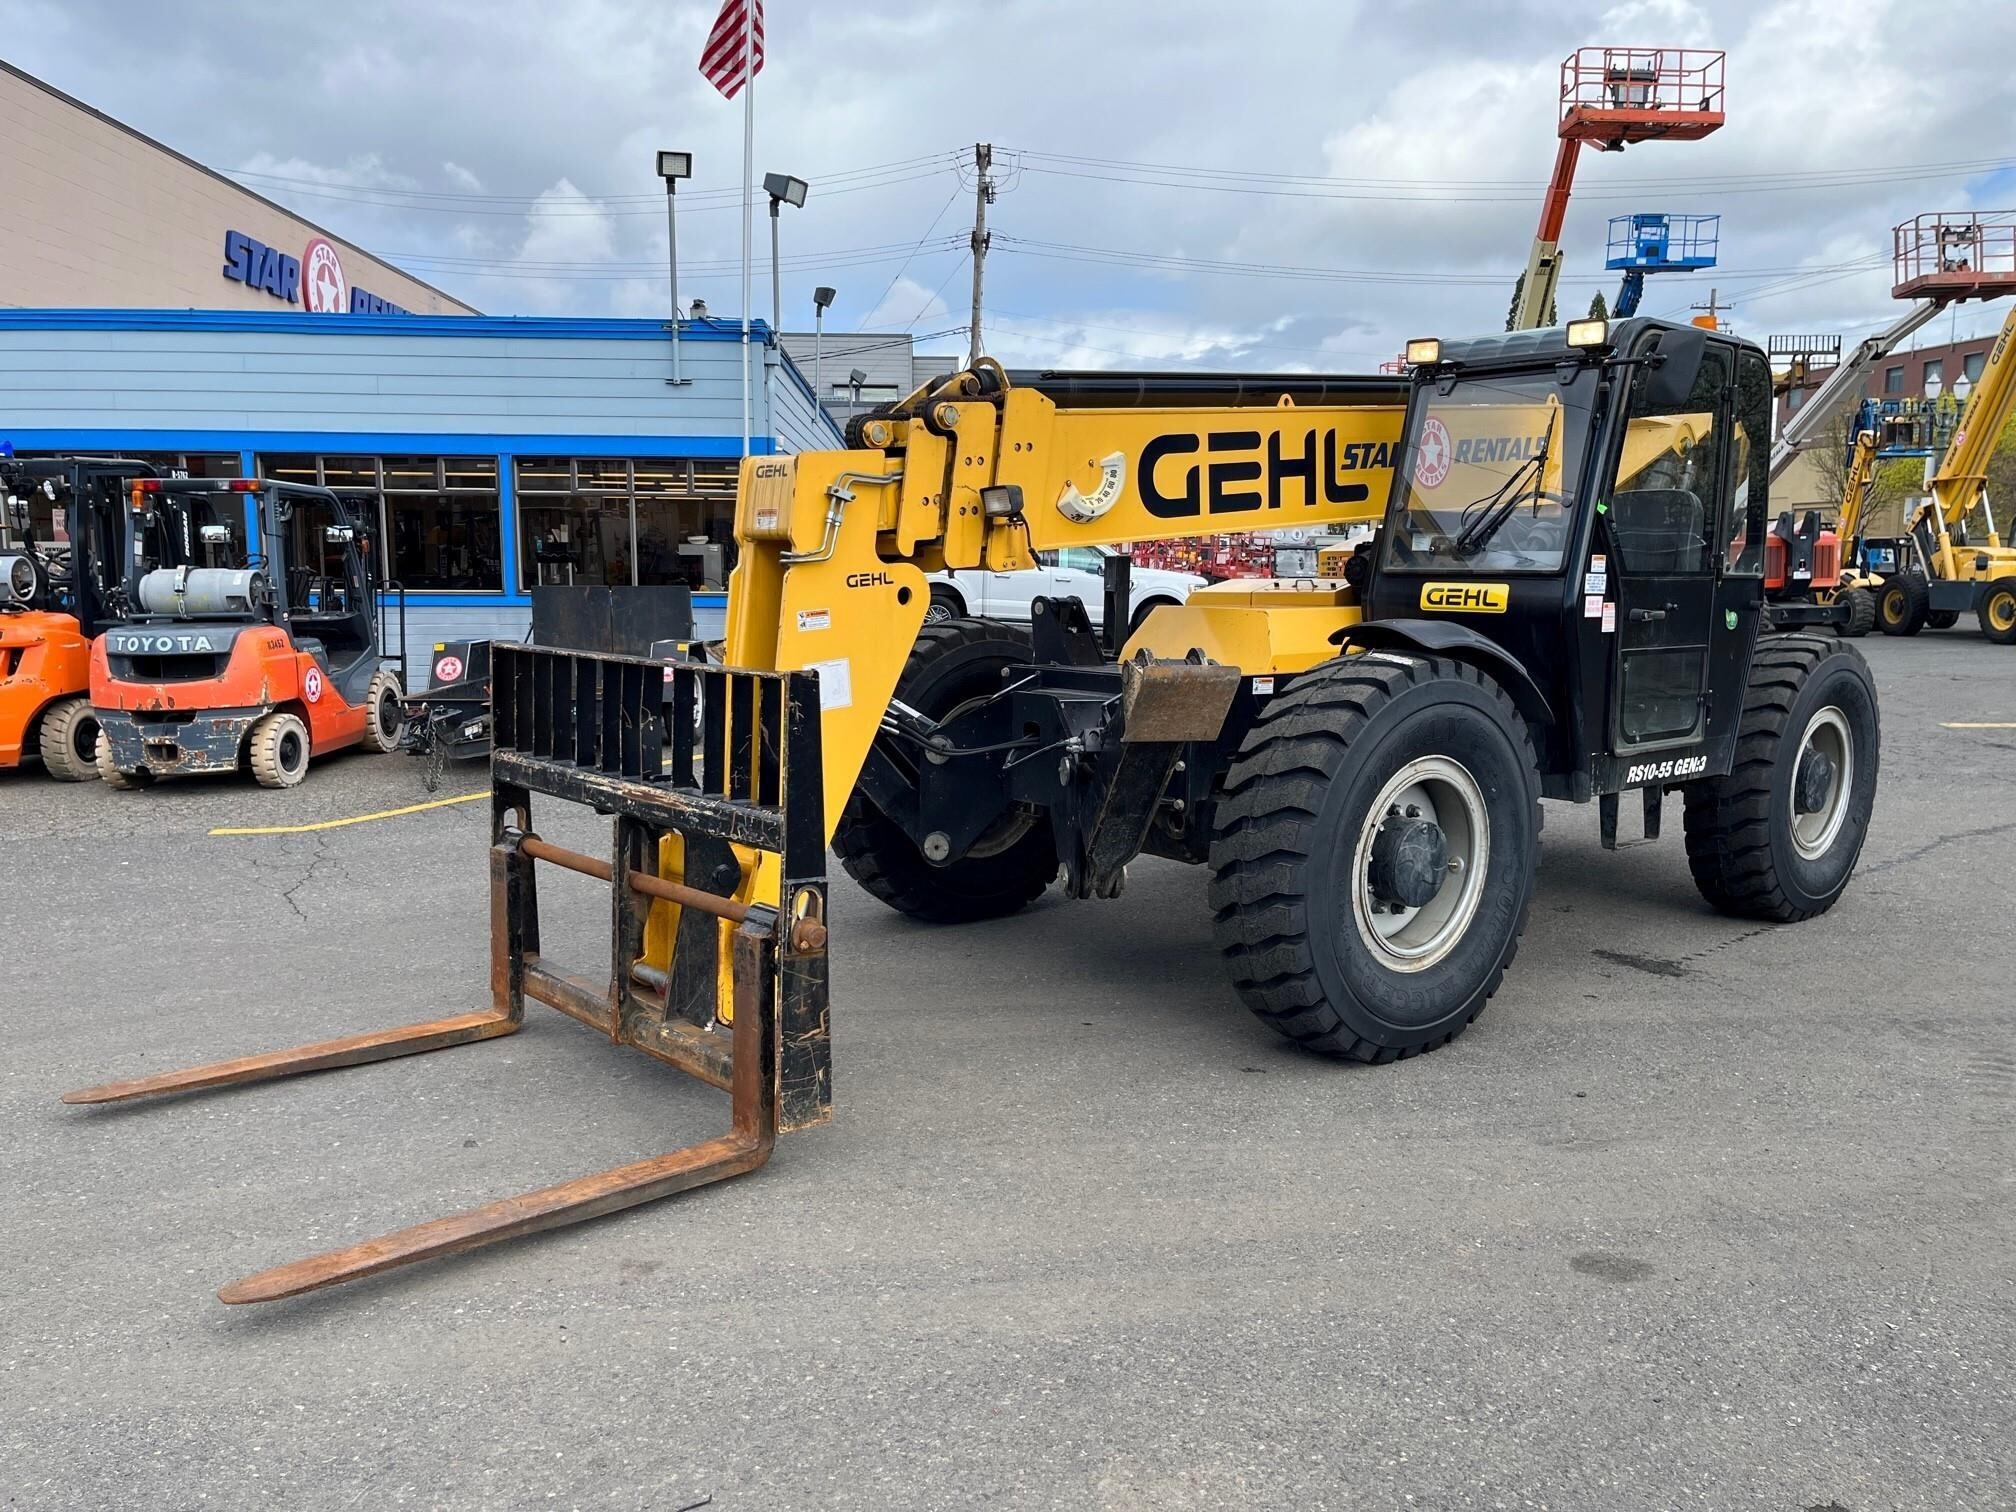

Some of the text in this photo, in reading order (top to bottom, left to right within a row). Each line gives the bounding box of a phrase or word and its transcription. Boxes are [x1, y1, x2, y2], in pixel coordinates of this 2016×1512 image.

[223, 229, 300, 304] STAR
[315, 247, 337, 270] STAR
[1991, 323, 2015, 365] GEHL
[756, 463, 788, 479] GEHL
[1138, 428, 1369, 518] GEHL
[1845, 462, 1861, 503] GEHL
[846, 572, 894, 588] GEHL
[1426, 587, 1499, 607] GEHL
[116, 636, 213, 652] TOYOTA
[1626, 760, 1674, 783] RS10-55
